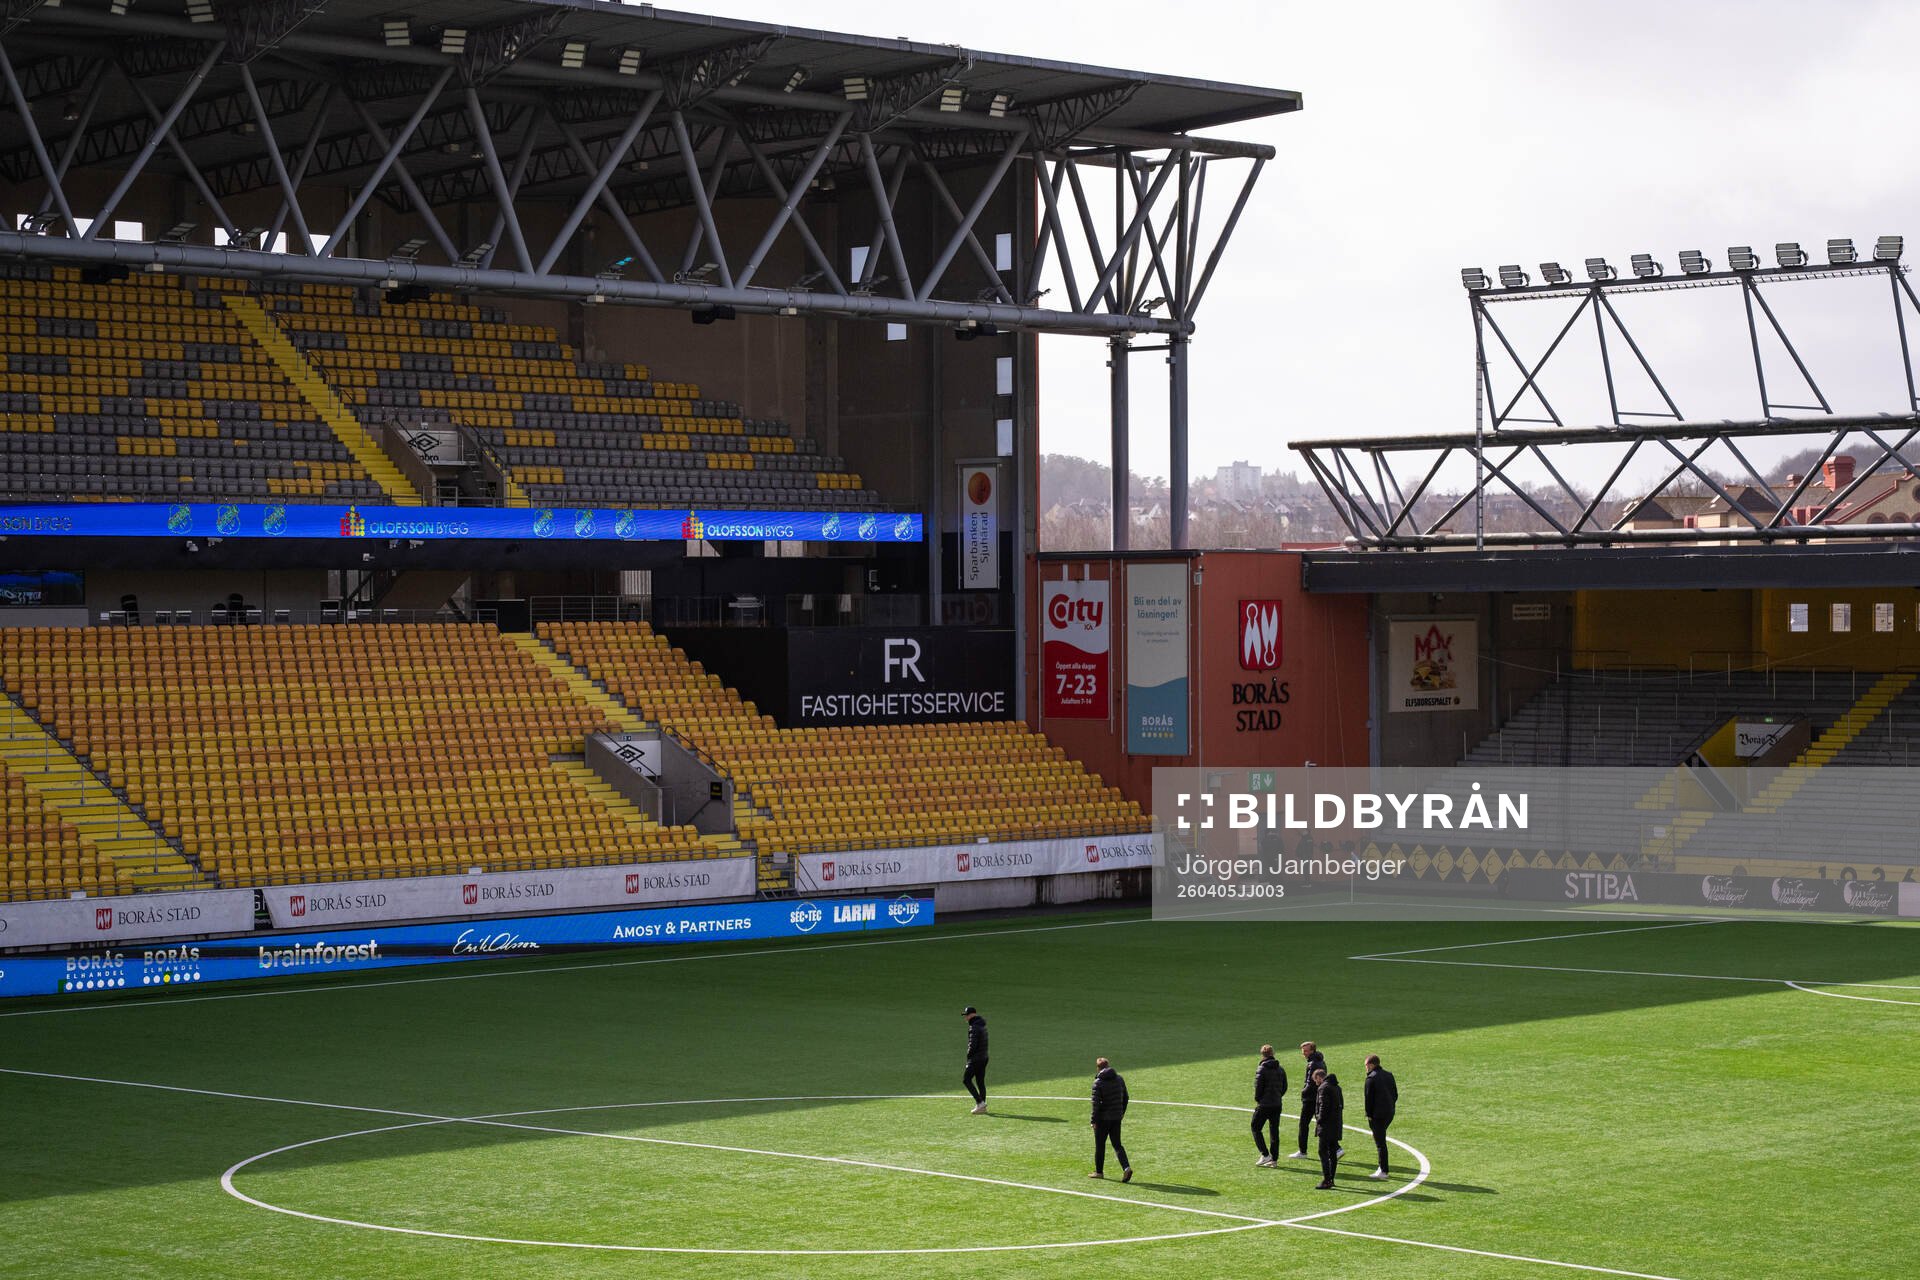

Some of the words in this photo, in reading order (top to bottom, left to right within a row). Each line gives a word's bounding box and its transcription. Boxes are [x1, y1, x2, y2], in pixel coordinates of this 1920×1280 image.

[369, 521, 434, 535] OLOFSSON
[436, 521, 469, 535] BYGG
[707, 524, 764, 537] OLOFSSON
[765, 524, 794, 538] BYGG
[969, 512, 980, 581] Sparbanken
[1048, 593, 1104, 630] City
[1056, 674, 1097, 695] 7-23
[1231, 676, 1290, 704] BORÅS
[801, 691, 1005, 717] FASTIGHETSSERVICE
[1142, 713, 1174, 726] BORÅS
[1235, 709, 1281, 732] STAD
[973, 852, 1005, 868] BORÅS
[1007, 853, 1032, 865] STAD
[1101, 845, 1135, 858] BORÅS
[838, 861, 872, 877] BORÅS
[875, 861, 901, 873] STAD
[643, 873, 681, 889] BORÅS
[683, 873, 710, 887] STAD
[1564, 872, 1639, 901] STIBA
[481, 883, 522, 900] BORÅS
[525, 883, 554, 897] STAD
[310, 893, 352, 912] BORÅS
[355, 894, 386, 908] STAD
[118, 907, 163, 925] BORÅS
[167, 907, 201, 922] STAD
[834, 903, 876, 923] LARM
[613, 925, 660, 939] AMOSY
[665, 922, 676, 934] &
[680, 918, 751, 934] PARTNERS
[453, 928, 490, 955] Erik
[66, 950, 124, 971] BORÅS
[143, 945, 200, 966] BORÅS
[259, 939, 382, 969] brainforest.
[66, 969, 124, 980] ELHANDEL
[143, 963, 200, 974] ELHANDEL
